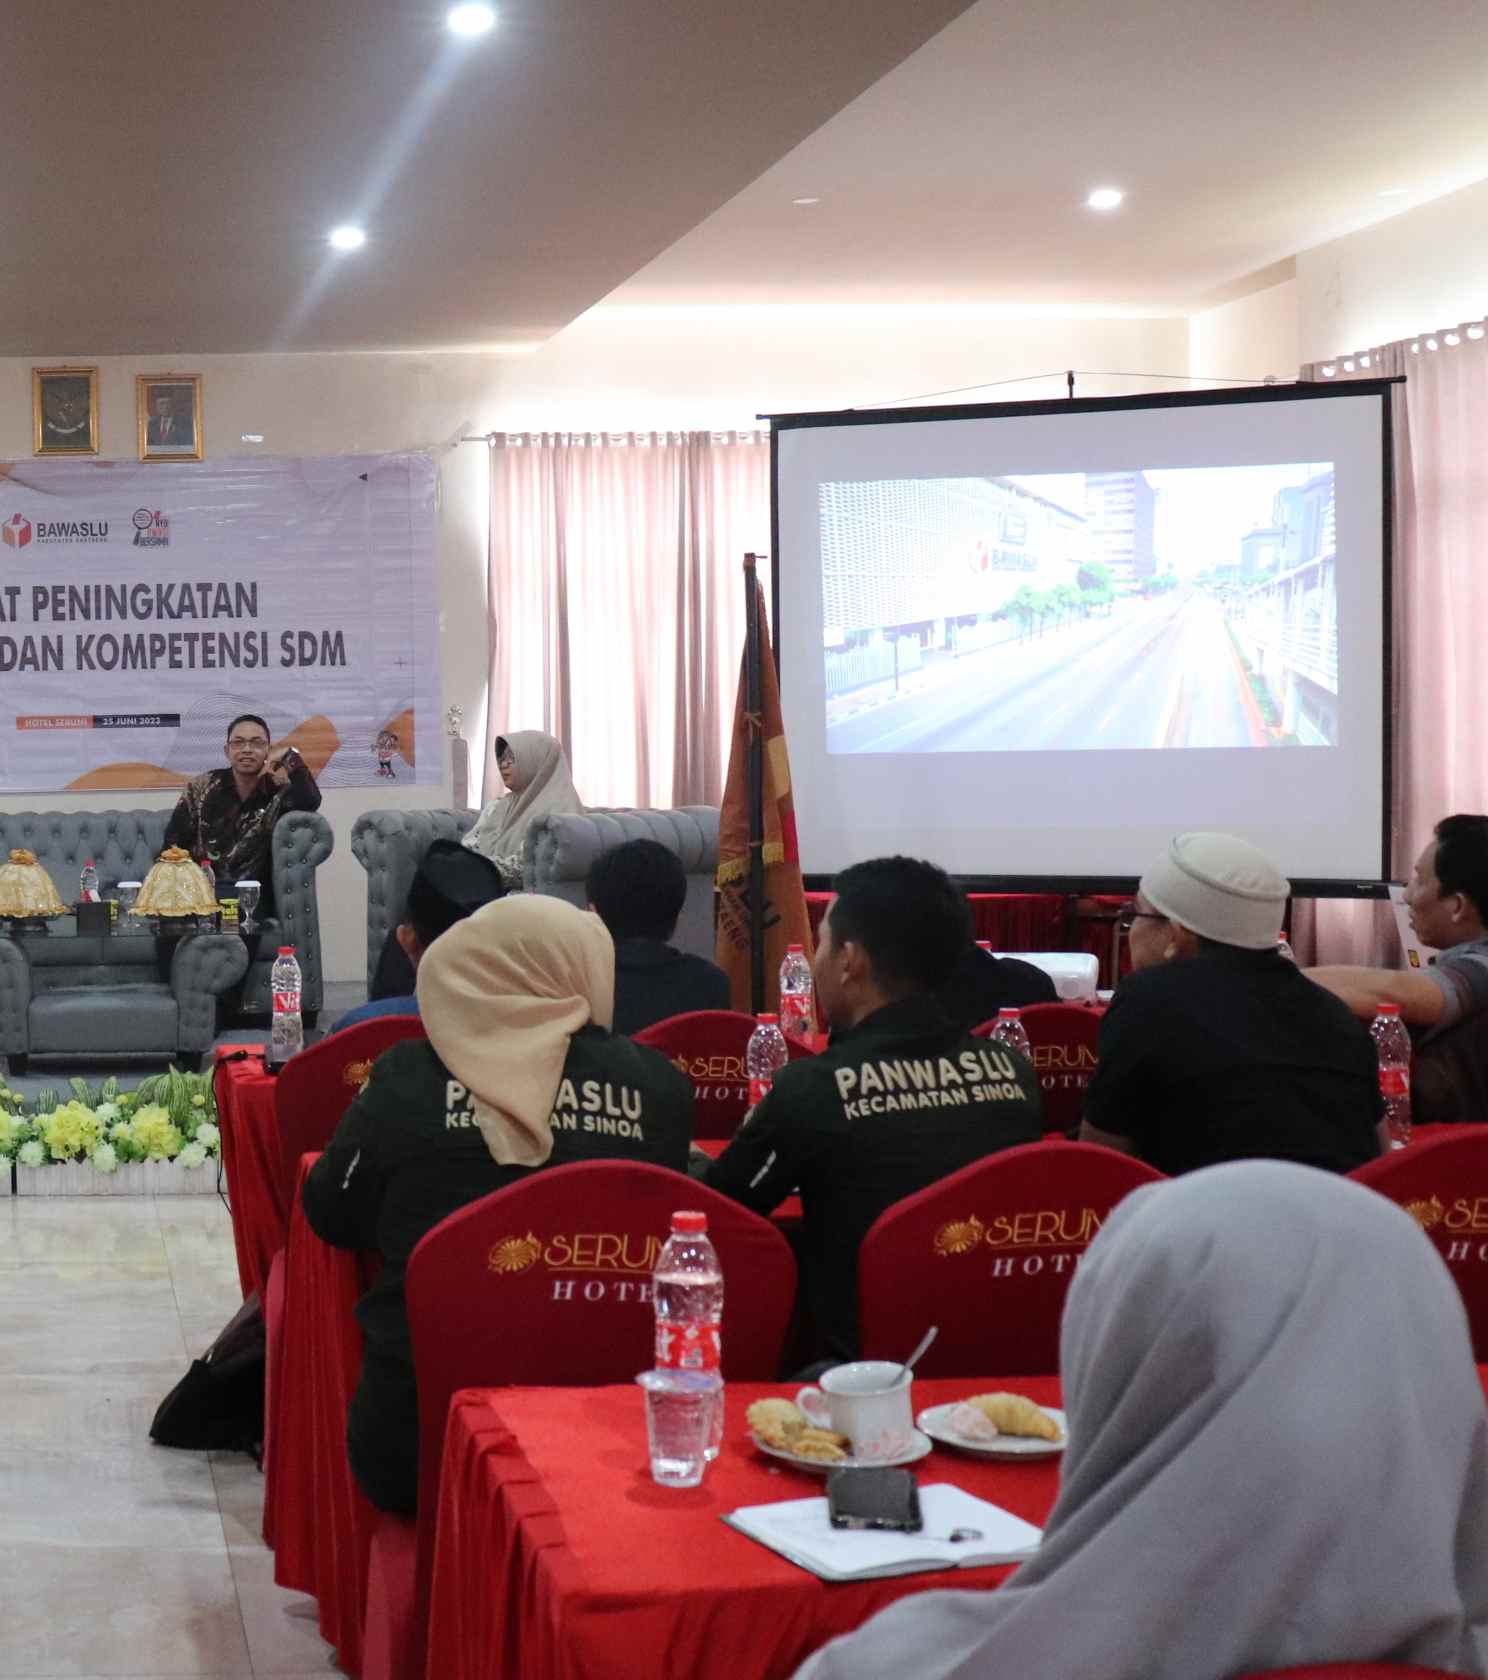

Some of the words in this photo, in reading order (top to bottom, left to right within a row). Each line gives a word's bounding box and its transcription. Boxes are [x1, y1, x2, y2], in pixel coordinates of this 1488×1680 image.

[36, 522, 109, 538] BAWASLU
[31, 581, 258, 622] PENINGKATAN
[75, 631, 269, 670] KOMPETENSI
[280, 630, 346, 668] SDM
[115, 716, 138, 726] JUNI
[139, 715, 161, 726] 2023
[834, 1049, 1017, 1100] PANWASLU
[843, 1088, 969, 1121] KECAMATAN
[971, 1083, 1027, 1102] SINOA
[583, 1114, 644, 1141] SINOA
